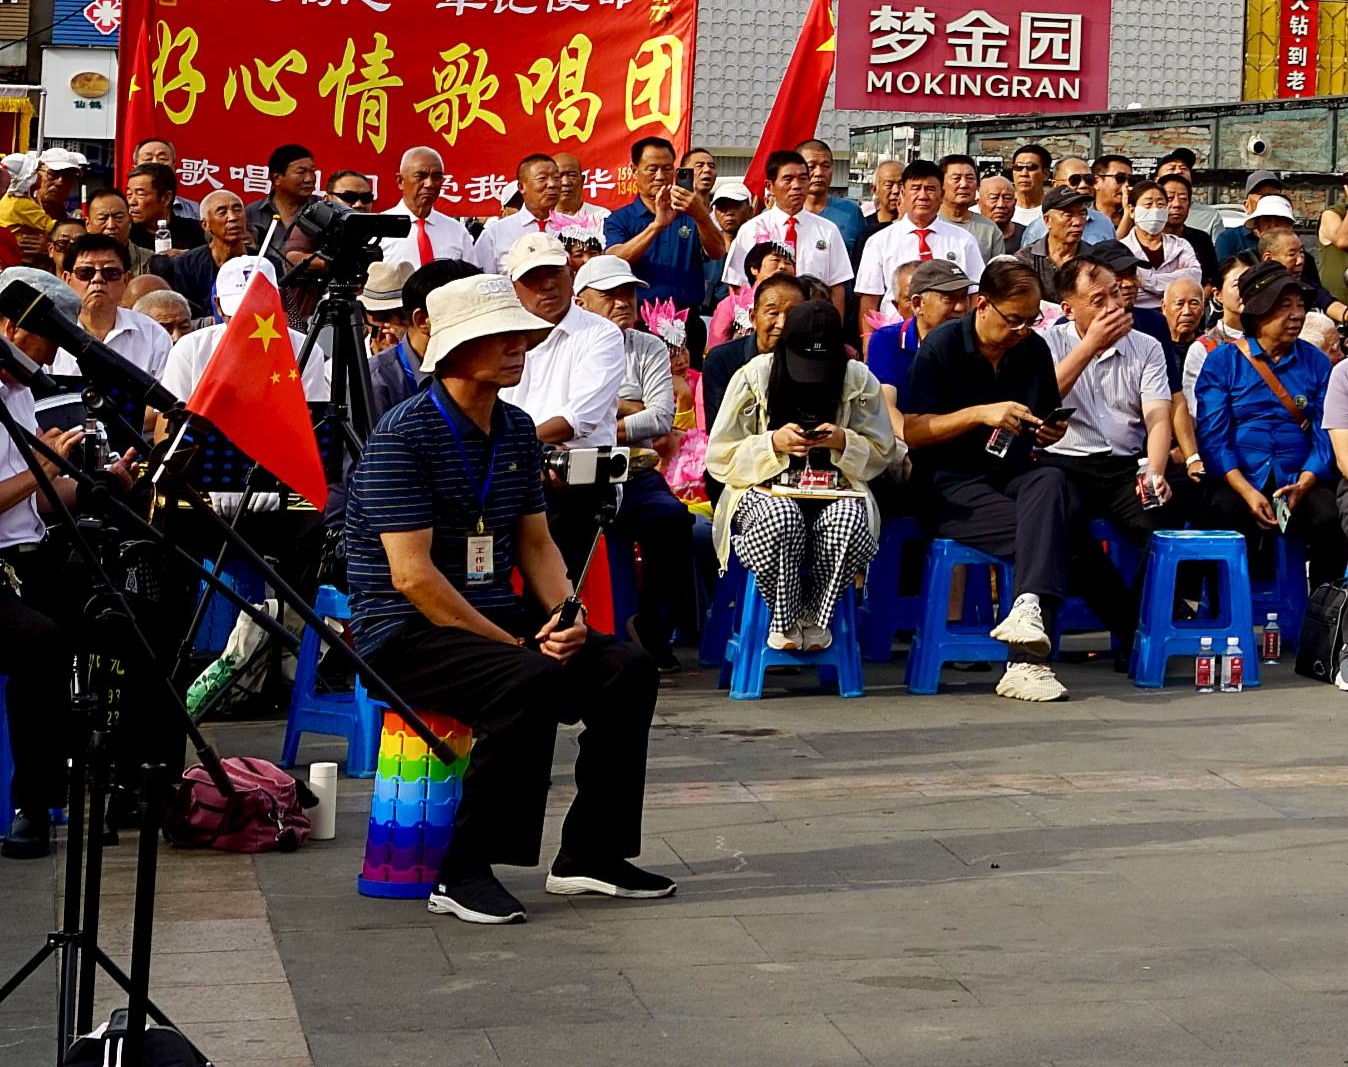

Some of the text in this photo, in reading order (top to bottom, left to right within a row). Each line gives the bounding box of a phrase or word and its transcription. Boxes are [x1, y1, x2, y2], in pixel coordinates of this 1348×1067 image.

[868, 3, 1083, 72] 梦金园
[152, 19, 684, 154] 好心情歌唱团
[866, 71, 1081, 100] MOKINGRAN
